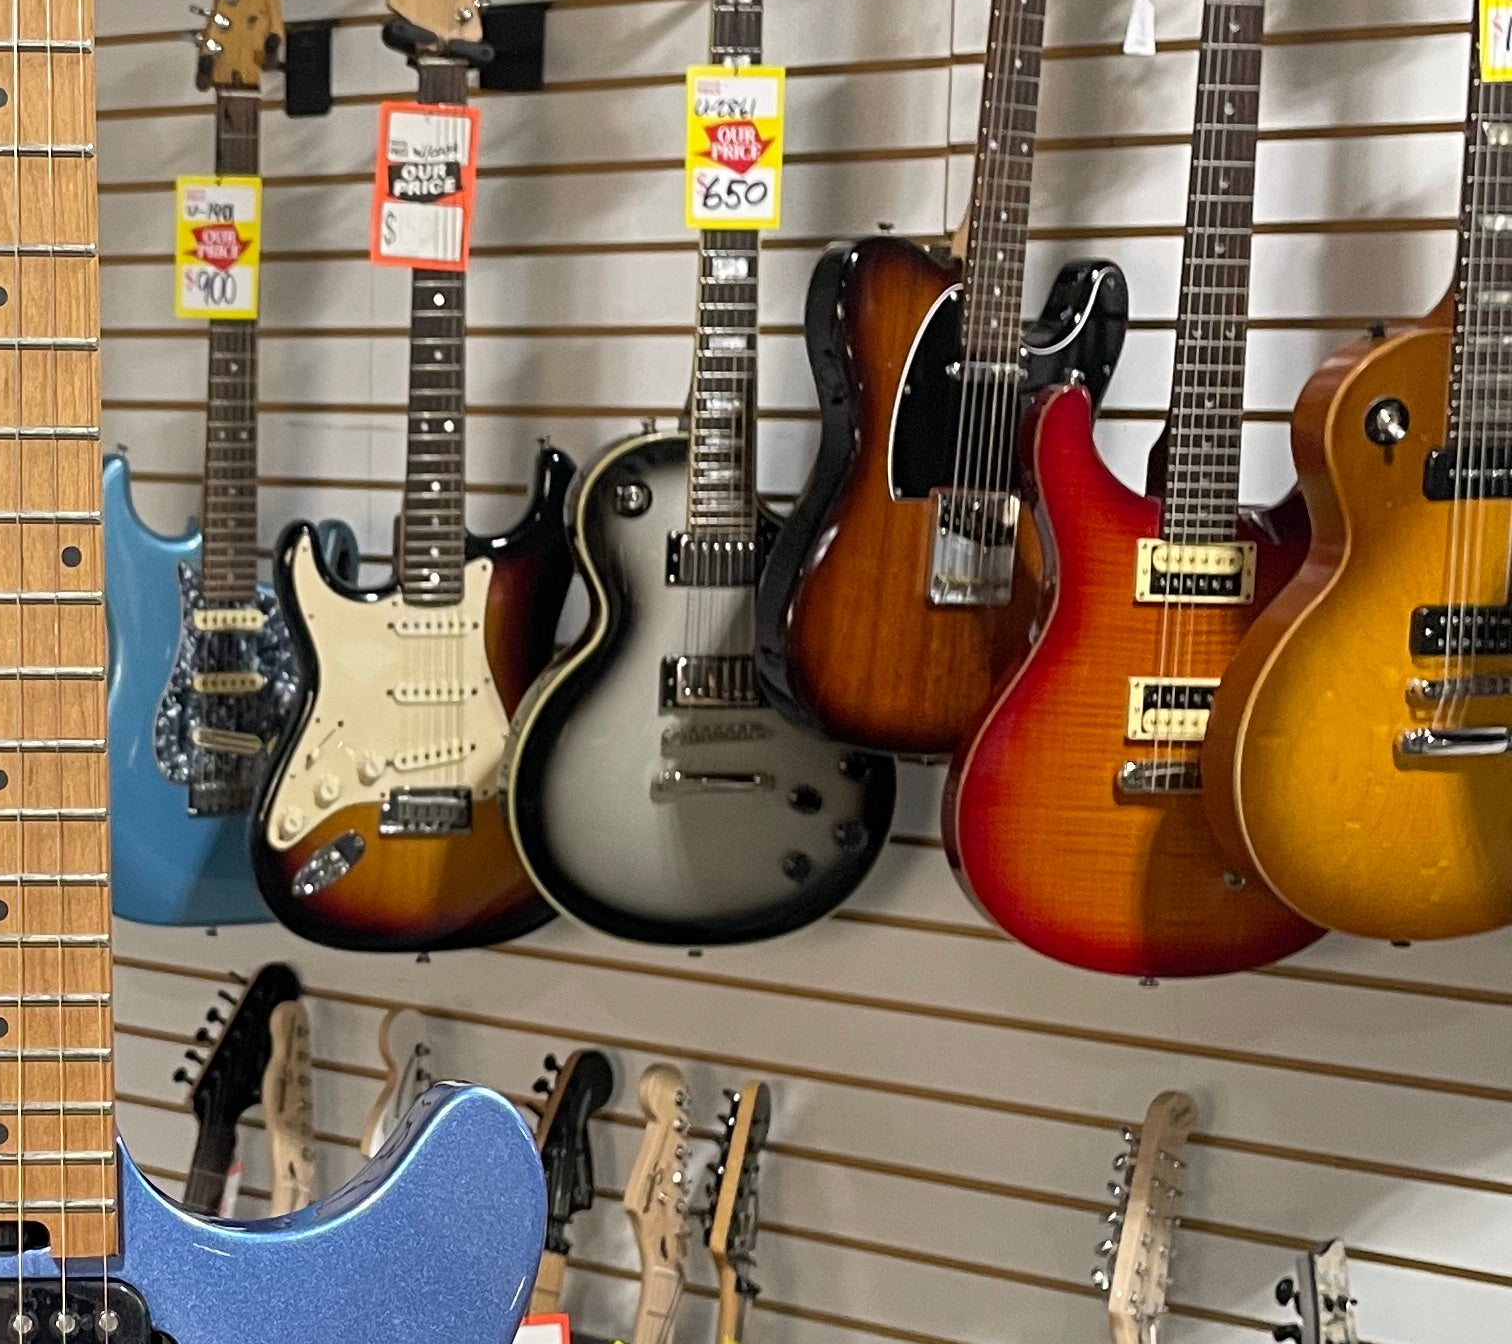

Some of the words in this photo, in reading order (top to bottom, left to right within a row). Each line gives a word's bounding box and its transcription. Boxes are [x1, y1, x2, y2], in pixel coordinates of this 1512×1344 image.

[716, 125, 757, 144] OUR
[710, 142, 763, 162] PRICE
[400, 163, 448, 181] OUR
[392, 178, 457, 197] PRICE
